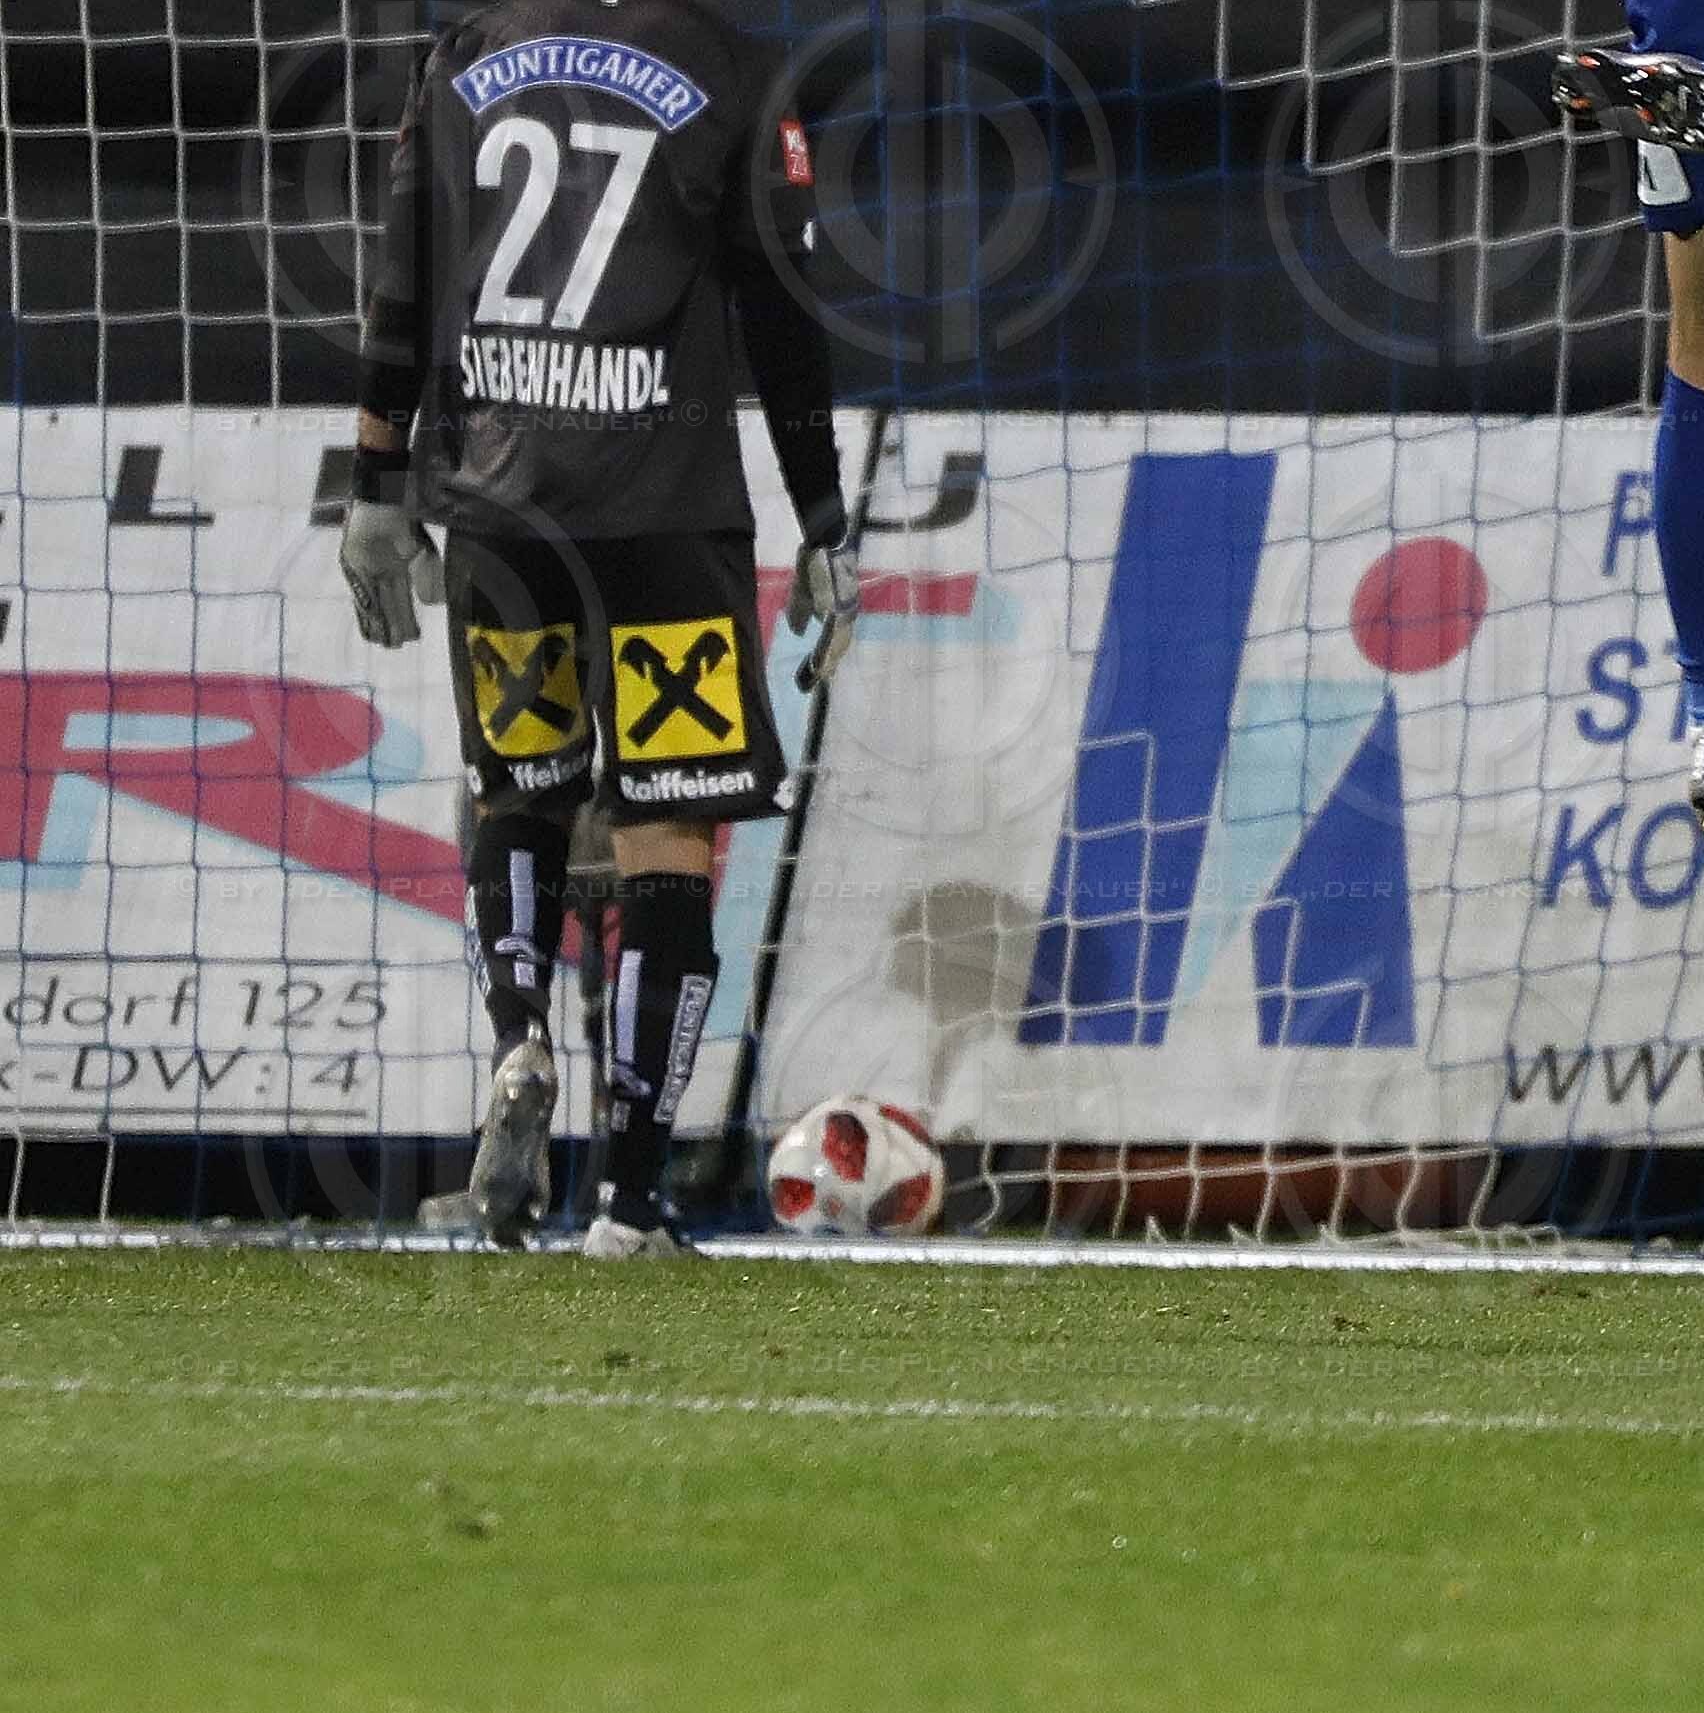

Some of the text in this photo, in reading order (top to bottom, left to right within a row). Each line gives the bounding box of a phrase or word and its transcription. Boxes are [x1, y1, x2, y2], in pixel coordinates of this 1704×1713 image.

[468, 45, 690, 118] PUNTIGAMER
[473, 116, 658, 331] 27
[459, 333, 671, 415] SIEBENHANDL
[619, 769, 755, 803] Raiffeisen
[238, 979, 389, 1029] 125
[308, 1049, 363, 1093] 4
